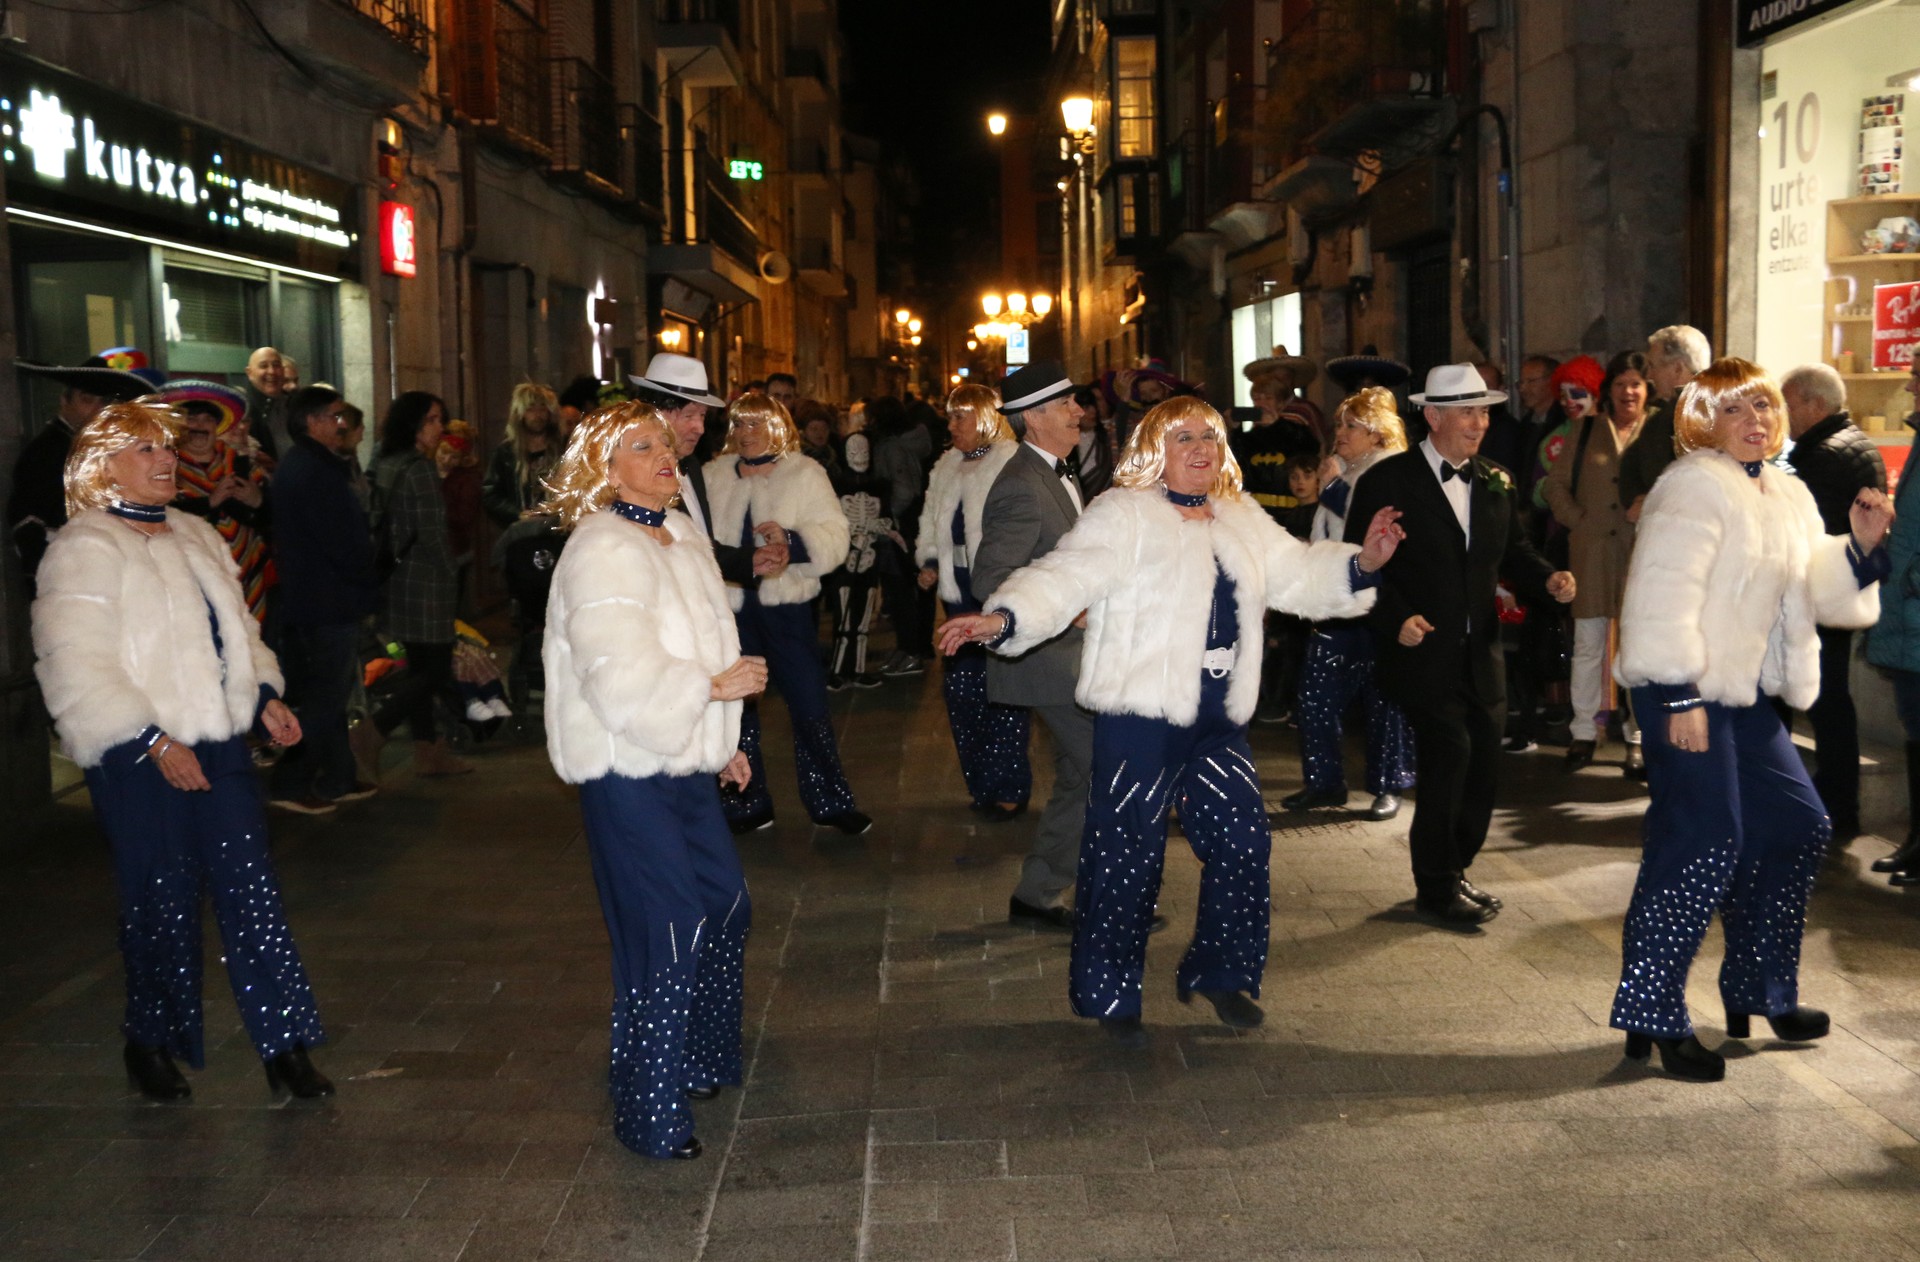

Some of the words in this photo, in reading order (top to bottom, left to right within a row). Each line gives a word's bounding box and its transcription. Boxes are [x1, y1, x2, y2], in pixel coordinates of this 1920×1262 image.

[1748, 0, 1820, 31] AUDIO
[1773, 91, 1821, 169] 10
[83, 117, 198, 205] kutxa
[1770, 171, 1819, 212] urte
